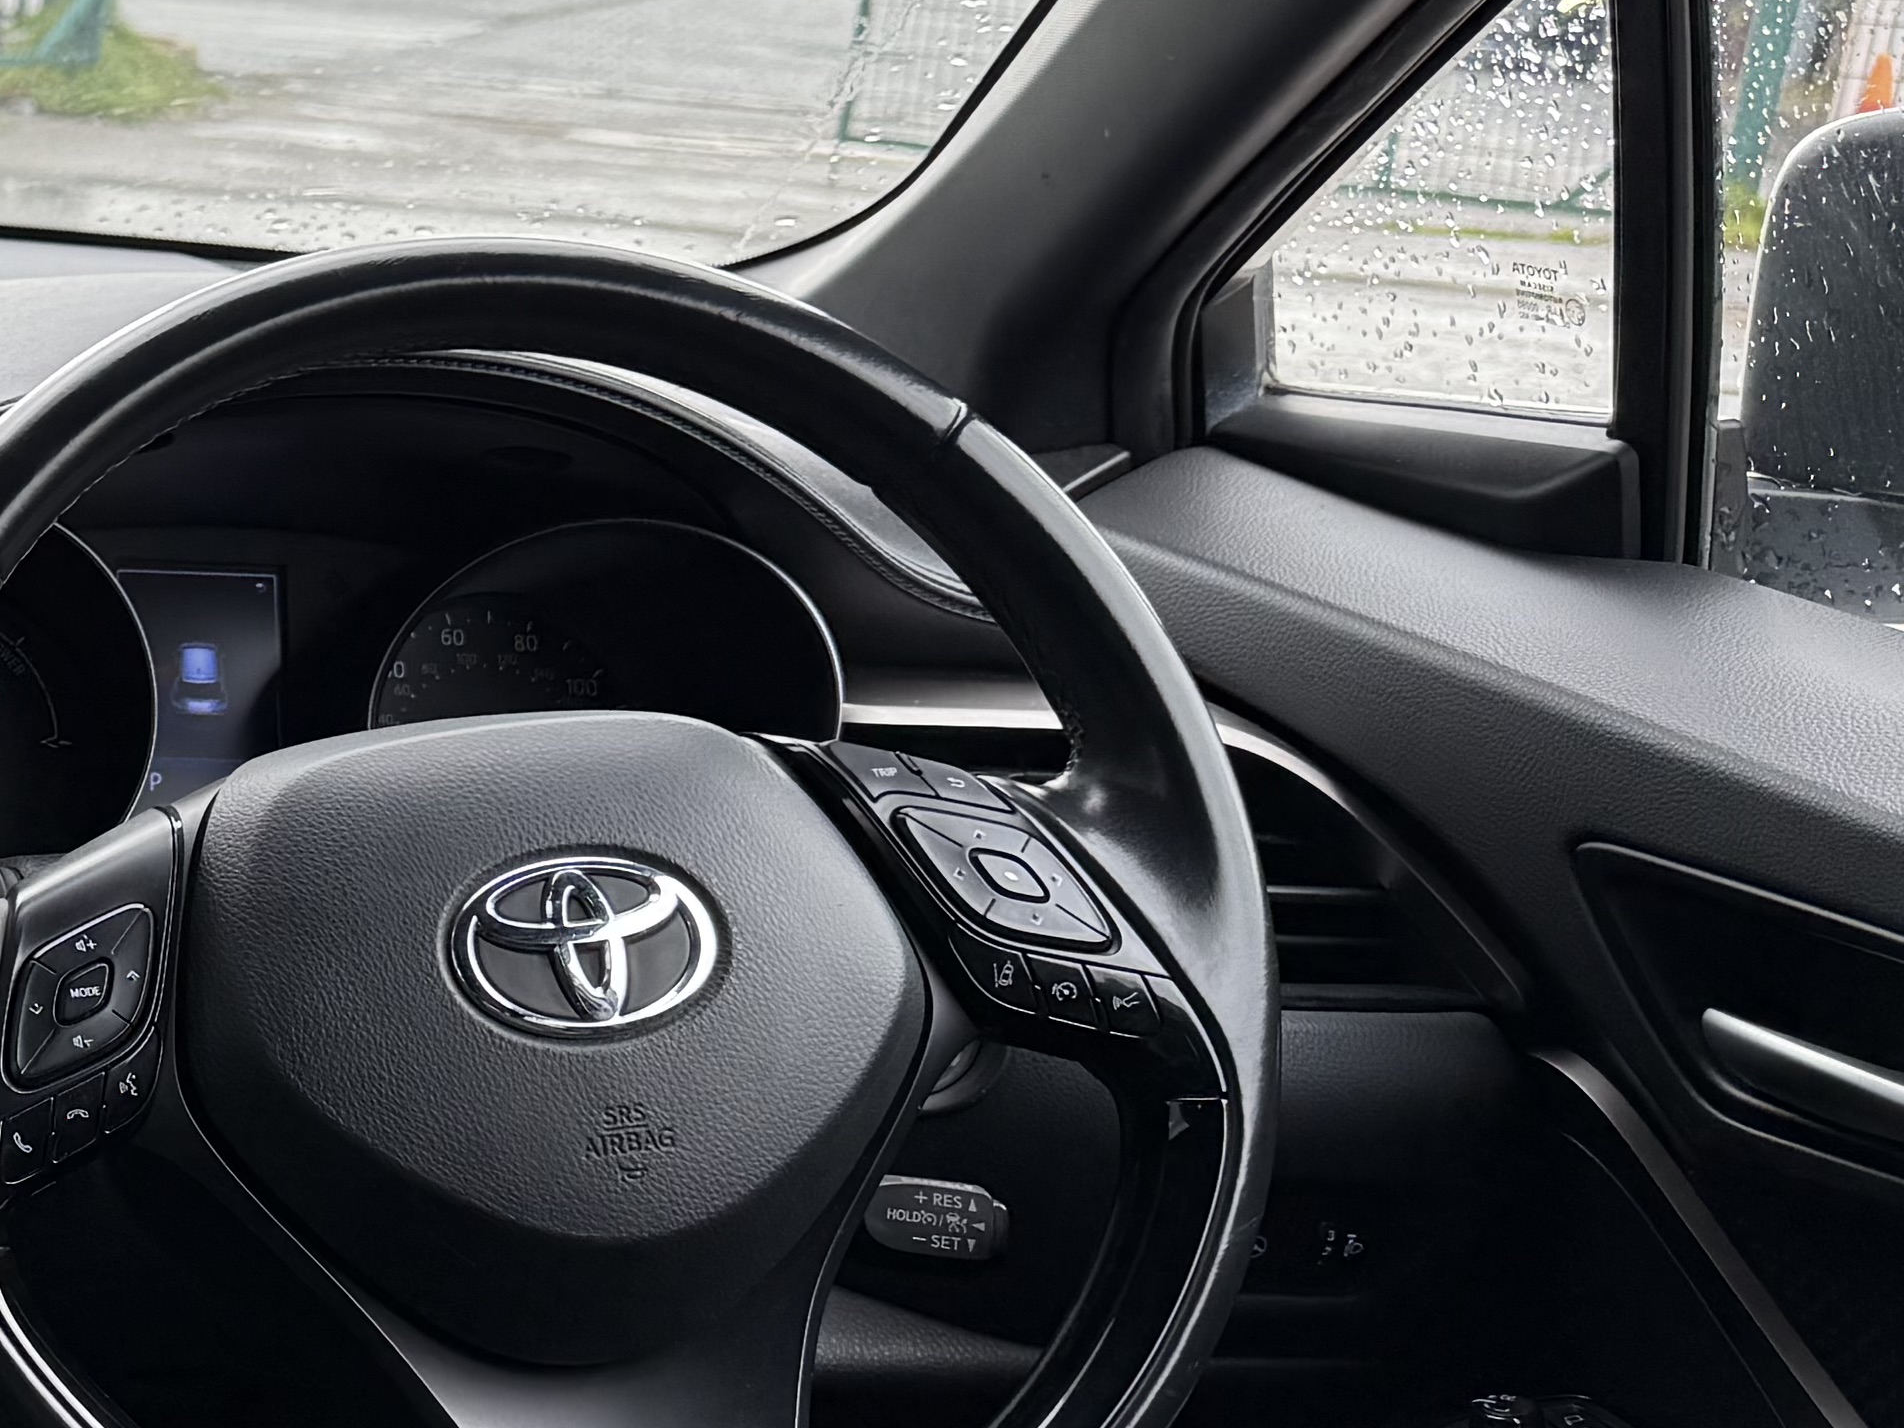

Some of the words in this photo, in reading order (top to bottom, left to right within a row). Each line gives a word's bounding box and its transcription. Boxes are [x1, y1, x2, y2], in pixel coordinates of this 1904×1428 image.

[440, 627, 465, 647] 60
[513, 633, 539, 652] 80
[565, 677, 598, 697] 100
[149, 772, 163, 791] P
[69, 986, 101, 999] MODE
[602, 1102, 647, 1125] SRS
[585, 1127, 676, 1160] AIRBAG
[932, 1192, 963, 1209] RES
[886, 1208, 922, 1223] HOLD
[930, 1234, 962, 1251] SET
